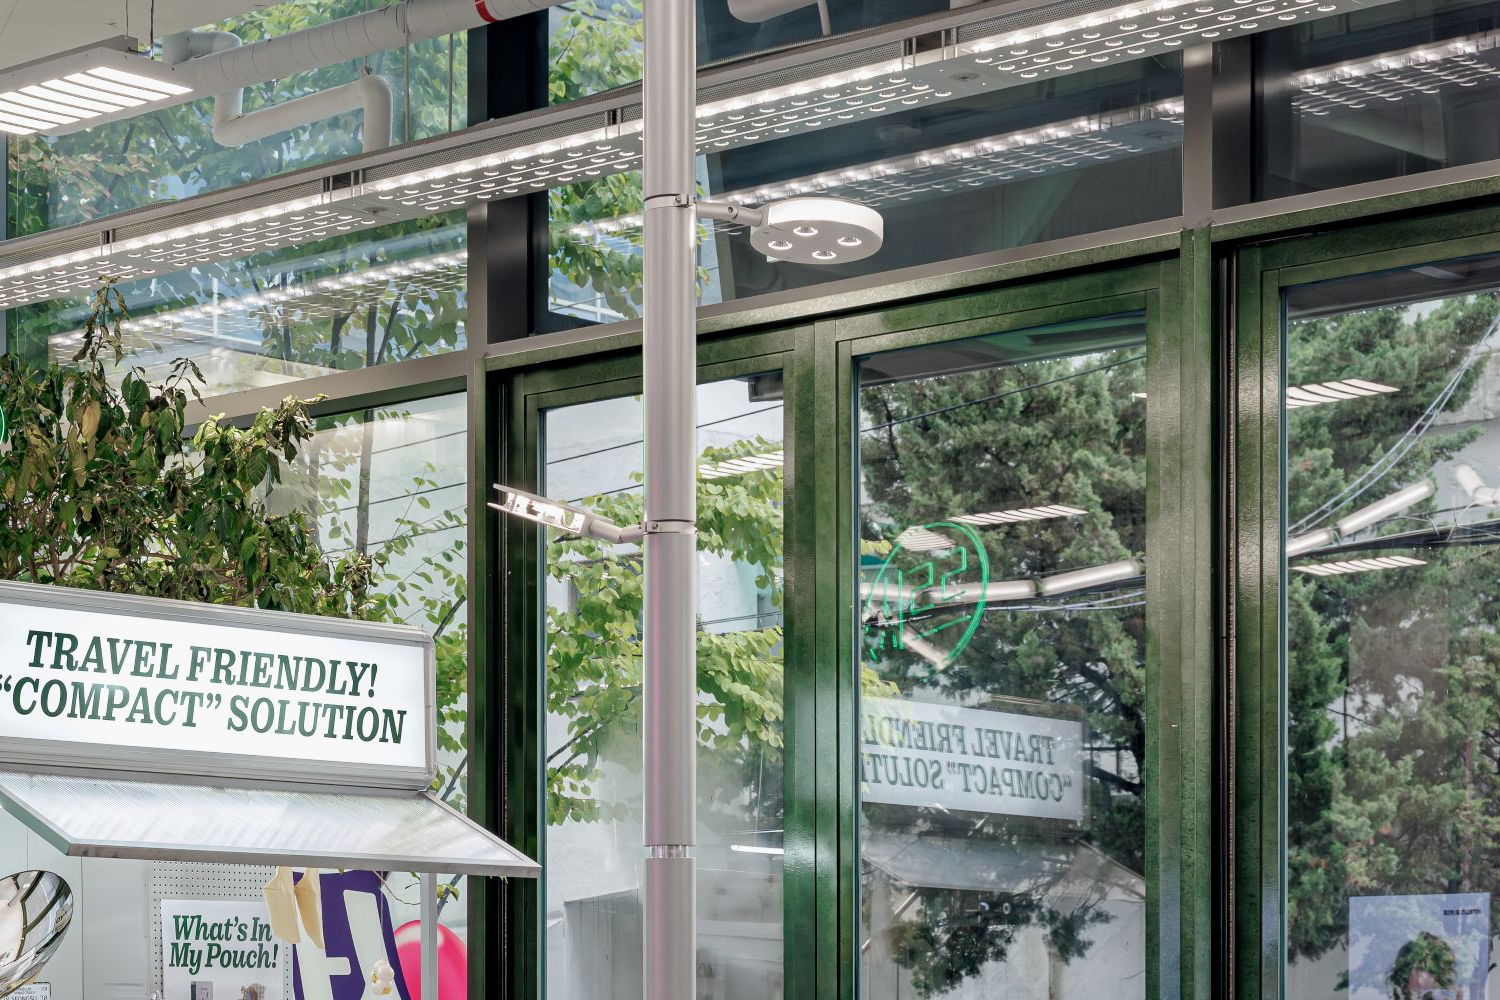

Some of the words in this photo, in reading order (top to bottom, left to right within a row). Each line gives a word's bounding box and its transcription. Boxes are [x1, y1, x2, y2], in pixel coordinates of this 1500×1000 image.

[27, 629, 178, 679] TRAVEL
[188, 645, 379, 698] FRIENDLY!
[227, 698, 407, 744] SOLUTION
[250, 917, 272, 942] In
[169, 942, 202, 976] My
[205, 943, 279, 969] Pouch!
